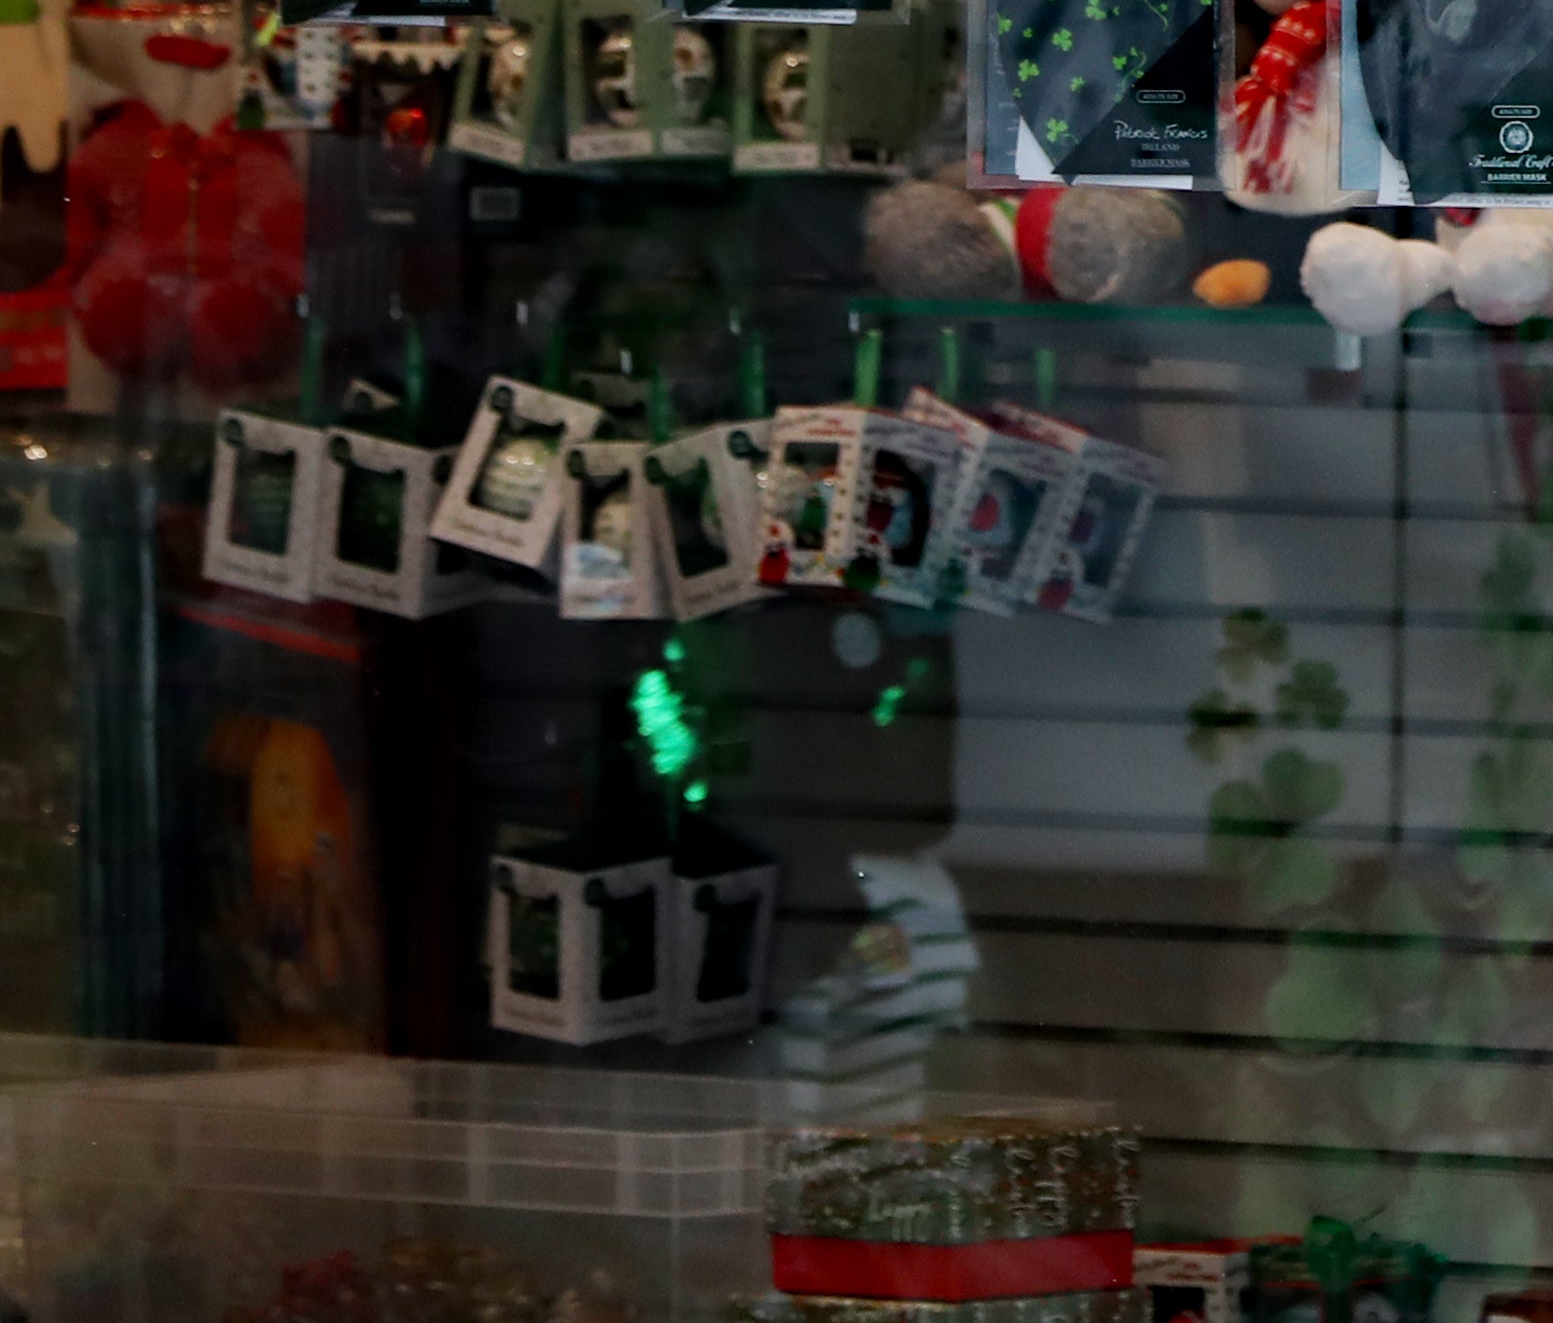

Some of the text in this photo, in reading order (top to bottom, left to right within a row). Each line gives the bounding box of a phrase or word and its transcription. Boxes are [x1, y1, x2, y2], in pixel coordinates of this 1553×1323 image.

[1468, 154, 1521, 169] Traditional
[1525, 154, 1552, 171] Craft
[1487, 173, 1548, 182] BARRIER MASK
